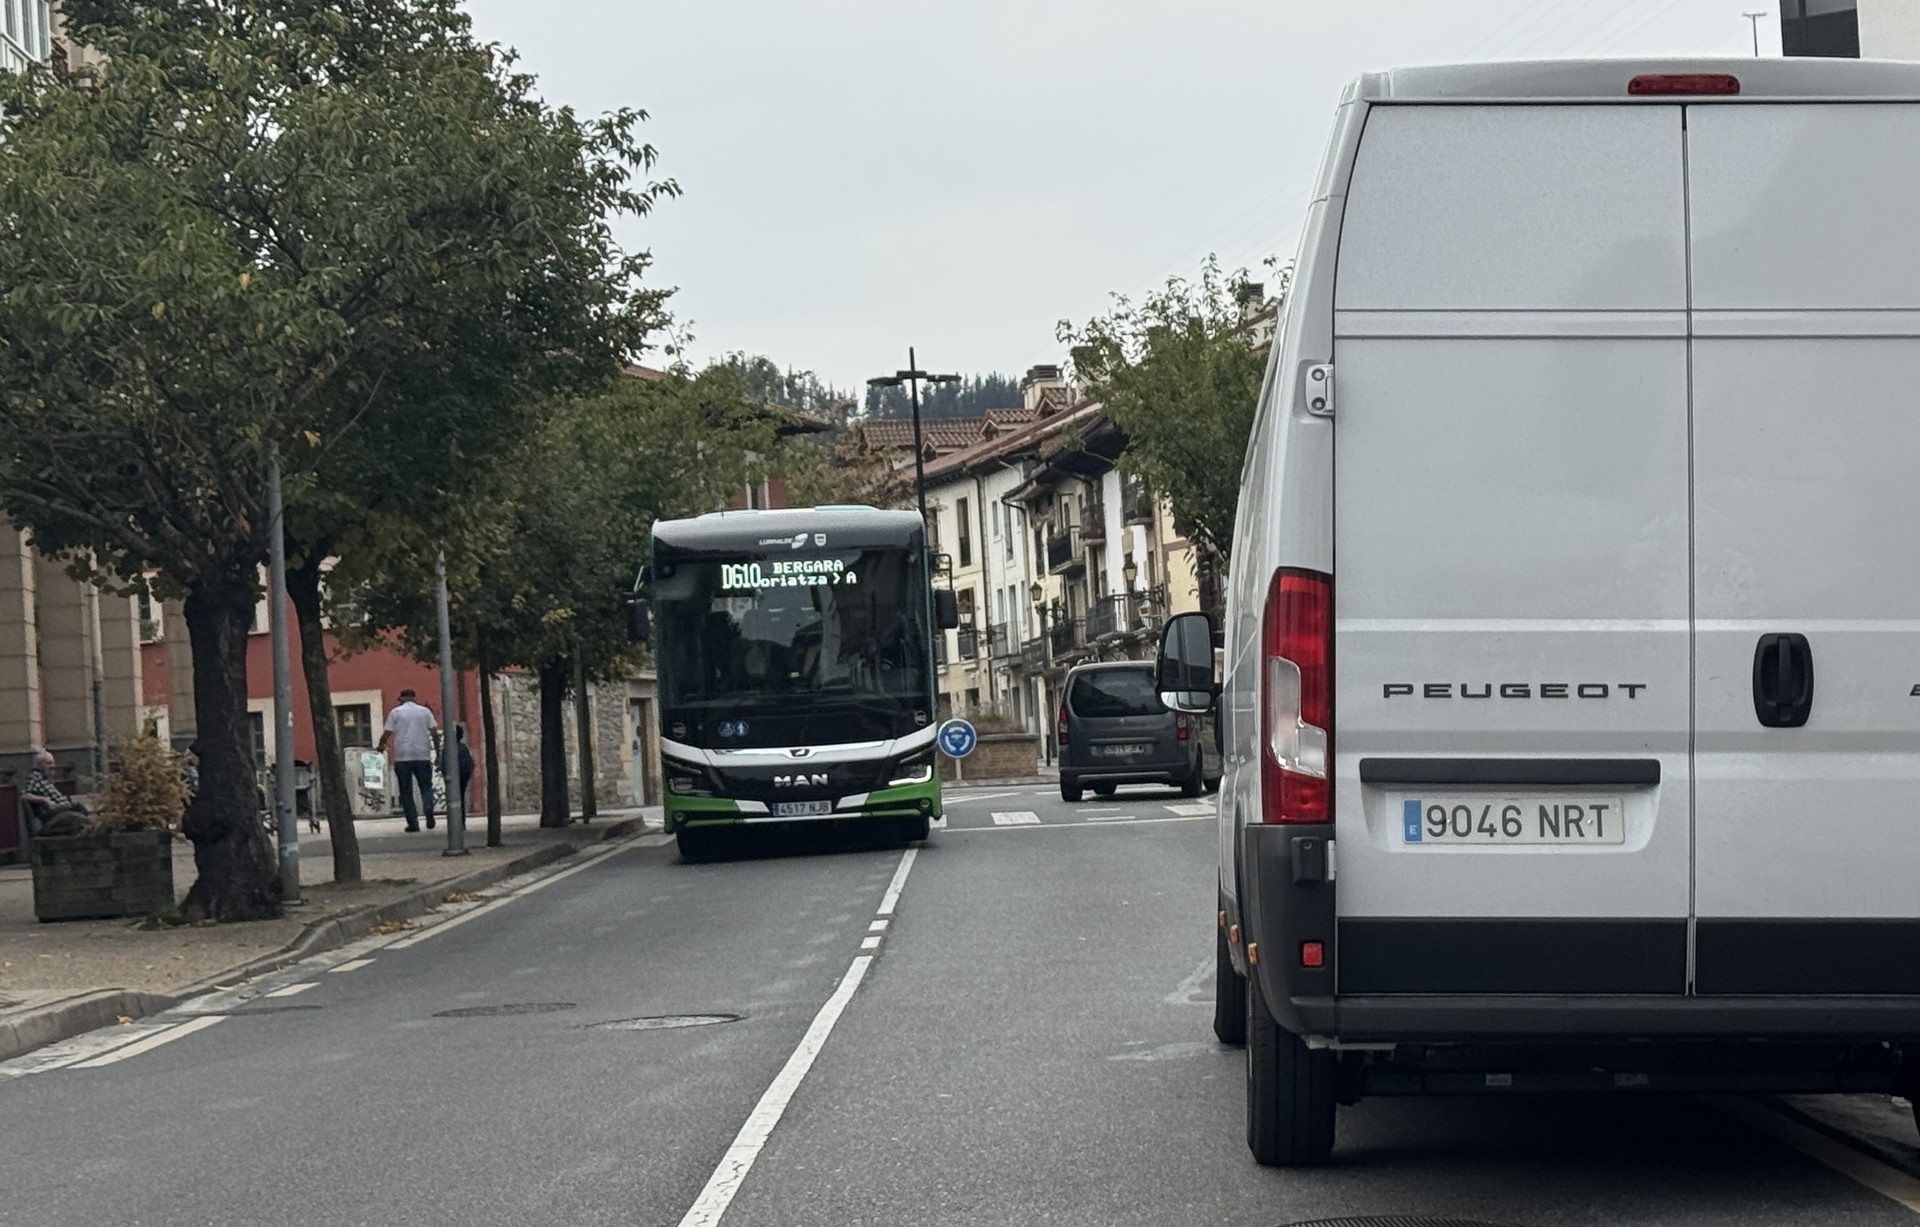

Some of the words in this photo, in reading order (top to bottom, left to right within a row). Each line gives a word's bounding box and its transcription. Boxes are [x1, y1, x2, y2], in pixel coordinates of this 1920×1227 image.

[773, 560, 844, 575] BERGARA
[721, 563, 761, 589] DG10
[846, 571, 857, 584] A
[1383, 683, 1647, 699] PEUGEOT
[774, 774, 828, 787] MAN
[780, 803, 806, 814] 4517
[1409, 824, 1418, 835] E
[1426, 804, 1523, 838] 9046
[1539, 804, 1610, 838] NRT
